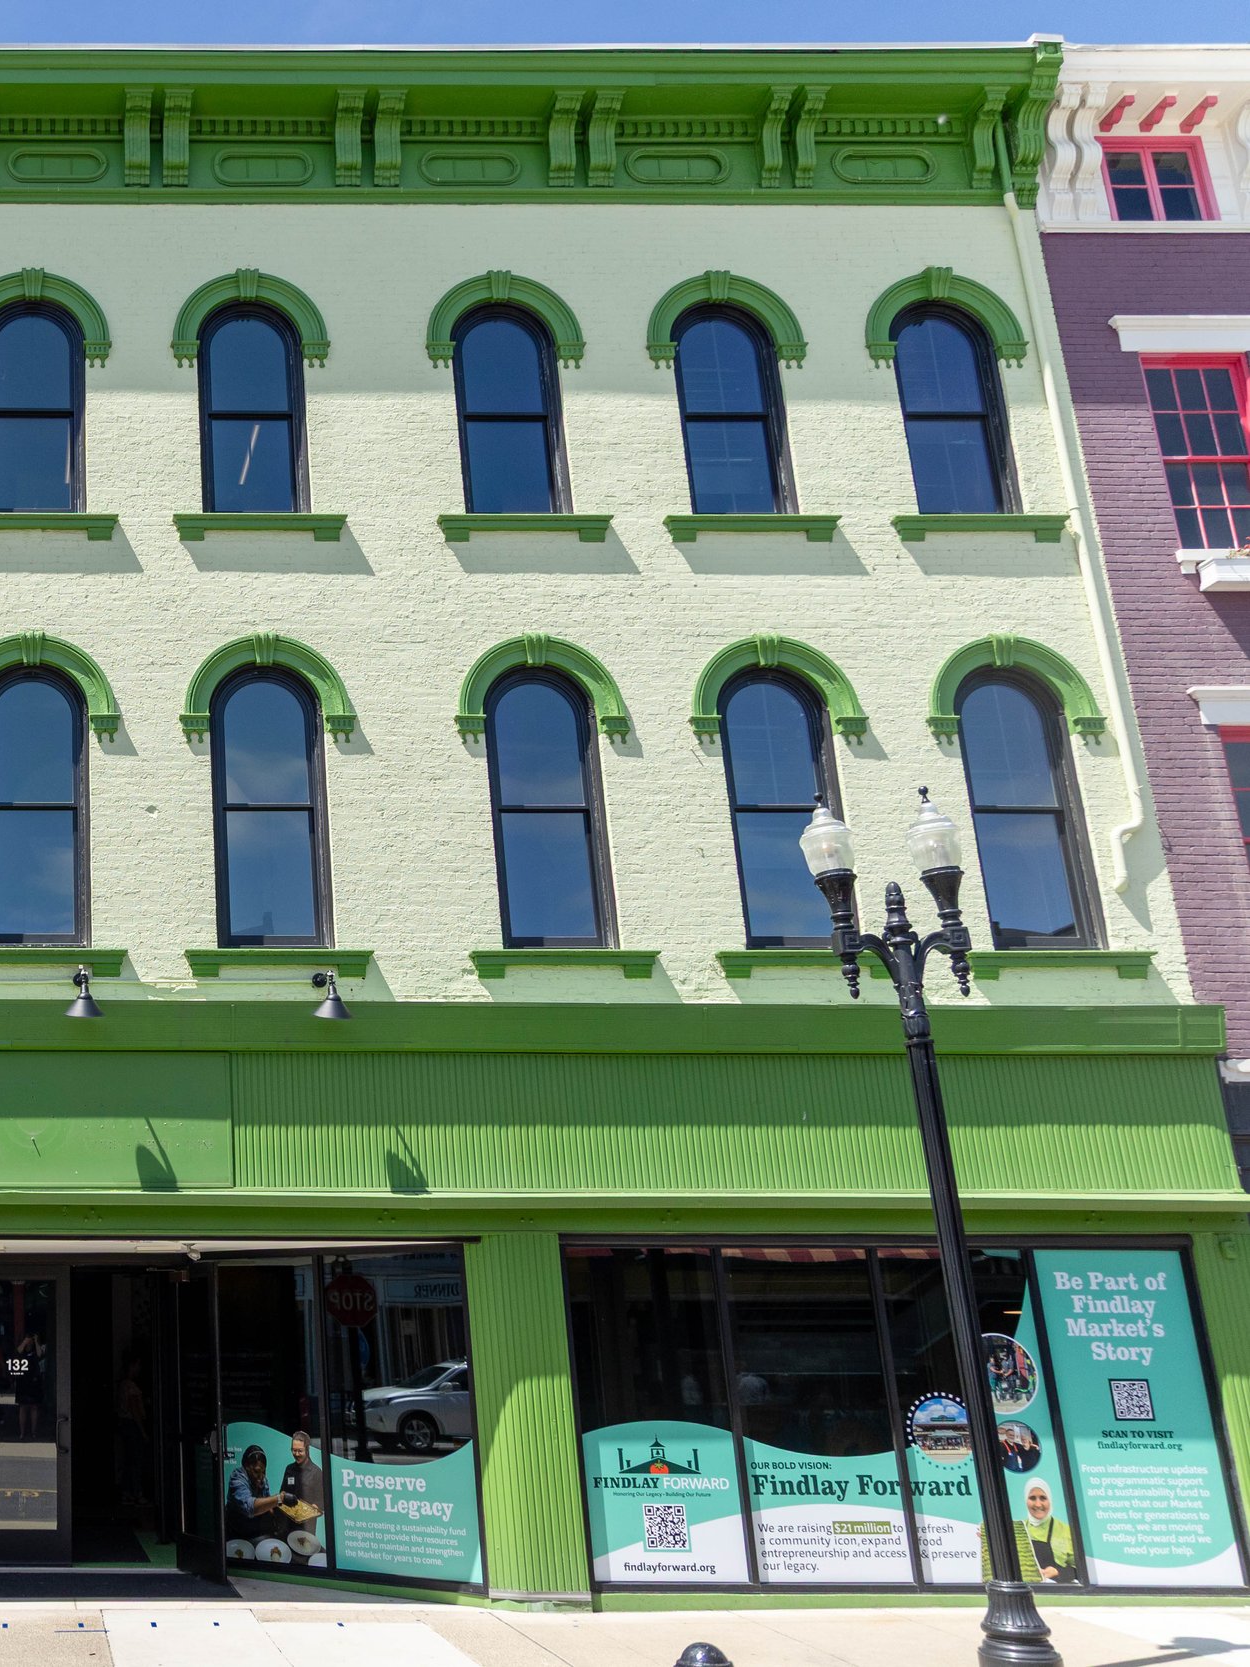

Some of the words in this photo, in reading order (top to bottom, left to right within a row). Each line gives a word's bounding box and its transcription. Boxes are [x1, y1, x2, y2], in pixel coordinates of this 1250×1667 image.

[1053, 1271, 1083, 1290] Be
[1087, 1271, 1139, 1290] Part
[1144, 1272, 1167, 1290] of
[1071, 1295, 1156, 1319] Findlay
[1065, 1318, 1165, 1337] Market's
[1090, 1341, 1153, 1366] Story
[6, 1359, 29, 1371] 132
[1102, 1430, 1128, 1438] SCAN
[1130, 1430, 1145, 1439] TO
[1146, 1430, 1174, 1438] VISIT
[1097, 1441, 1183, 1451] findlayforward.org
[750, 1462, 770, 1470] OUR
[772, 1462, 796, 1470] BOLD
[798, 1462, 832, 1470] VISION:
[1081, 1464, 1105, 1473] From
[1107, 1465, 1168, 1473] infrastructure
[1171, 1465, 1208, 1475] updates
[342, 1469, 426, 1492] Preserve
[593, 1477, 660, 1489] FINDLAY
[663, 1478, 730, 1490] FORWARD
[1090, 1477, 1100, 1485] to
[1102, 1477, 1165, 1487] programmatic
[1167, 1478, 1203, 1487] support
[751, 1474, 850, 1502] Findlay
[856, 1474, 973, 1496] Forward
[1087, 1487, 1104, 1496] and
[1115, 1488, 1174, 1498] sustainability
[1177, 1488, 1198, 1497] fund
[1200, 1489, 1210, 1497] to
[343, 1491, 380, 1511] Our
[384, 1494, 454, 1522] Legacy
[1132, 1499, 1150, 1508] that
[1171, 1499, 1203, 1508] Market
[1096, 1510, 1128, 1519] thrives
[1129, 1510, 1142, 1519] for
[1144, 1511, 1198, 1521] generations
[1200, 1512, 1210, 1520] to
[368, 1521, 395, 1531] creating
[402, 1524, 448, 1536] sustainability
[449, 1527, 466, 1536] fund
[758, 1523, 774, 1533] We
[777, 1525, 794, 1533] are
[797, 1523, 832, 1535] raising
[834, 1523, 852, 1534] $21
[854, 1524, 891, 1533] million
[893, 1525, 903, 1533] to
[1107, 1524, 1134, 1532] come,
[1169, 1523, 1204, 1534] moving
[345, 1530, 374, 1539] designed
[384, 1533, 410, 1542] provide
[424, 1537, 458, 1546] resources
[769, 1537, 831, 1548] community
[861, 1536, 901, 1548] expand
[918, 1537, 943, 1546] food
[1103, 1534, 1136, 1544] Findlay
[1138, 1534, 1176, 1543] Forward
[1178, 1534, 1195, 1543] and
[380, 1543, 409, 1552] maintain
[411, 1545, 424, 1553] and
[426, 1547, 464, 1557] strengthen
[762, 1549, 850, 1560] entrepreneurship
[852, 1548, 871, 1558] and
[874, 1550, 907, 1558] access
[921, 1549, 929, 1558] &
[932, 1551, 977, 1561] preserve
[1124, 1546, 1147, 1554] need
[1150, 1547, 1169, 1557] your
[1172, 1546, 1194, 1557] help.
[358, 1551, 381, 1559] Market
[383, 1552, 392, 1560] for
[394, 1555, 412, 1563] years
[422, 1558, 443, 1566] come.
[624, 1562, 716, 1574] findlayforward.org
[763, 1563, 781, 1571] our
[784, 1561, 819, 1573] legacy.
